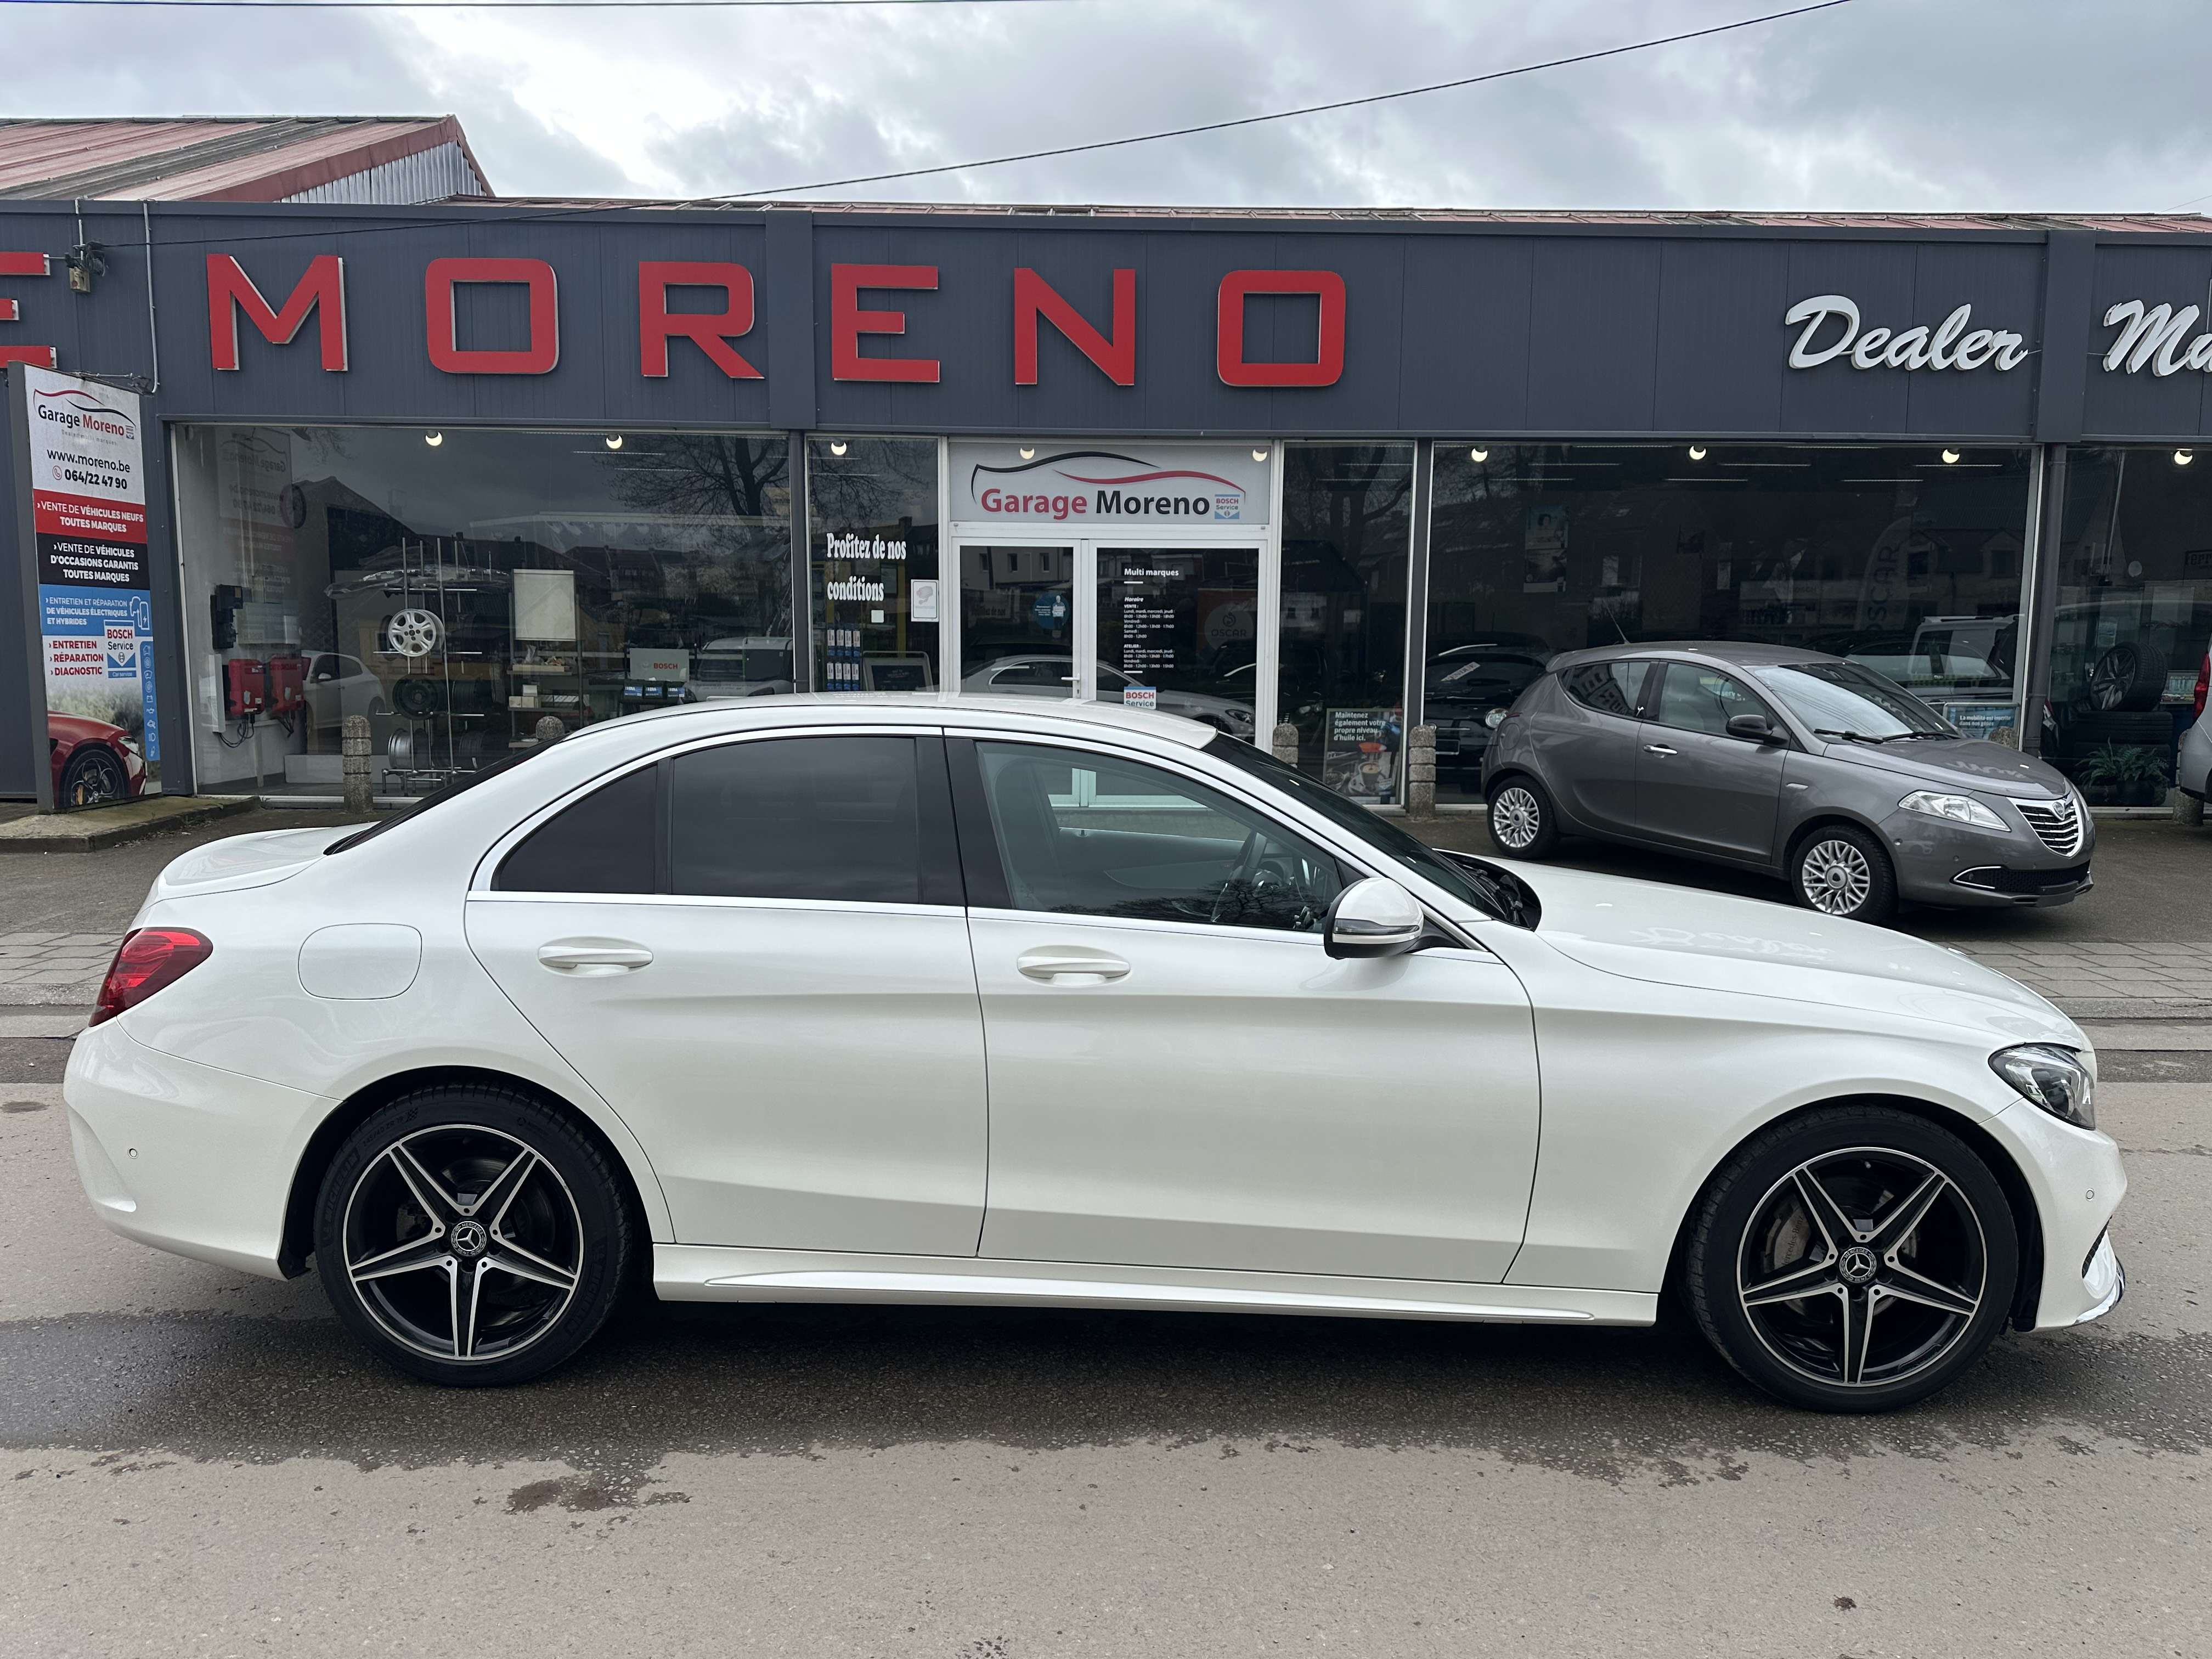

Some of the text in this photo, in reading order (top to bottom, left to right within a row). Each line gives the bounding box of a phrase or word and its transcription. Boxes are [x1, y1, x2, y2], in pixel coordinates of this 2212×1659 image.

[206, 253, 1346, 387] MORENO
[1785, 295, 2028, 370] Dealer
[38, 404, 80, 428] Garage
[83, 414, 124, 436] Moreno
[47, 449, 130, 473] www.moreno.be
[65, 469, 127, 489] 064/22 47 90
[41, 500, 143, 522] VENTE DE VÉHICULES NEUFS
[981, 488, 1210, 520] Garage Moreno
[60, 516, 127, 533] TOUTES MARQUES
[57, 542, 134, 557] VENTE DE VÉHICULES
[826, 532, 906, 560] Profitez de nos
[50, 555, 138, 571] D'OCCASIONS GARANTIS
[63, 568, 129, 583] TOUTES MARQUES
[827, 576, 884, 601] conditions
[49, 596, 83, 605] ENTRETIEN
[93, 598, 127, 607] RÉPARATION
[56, 606, 89, 616] VÉHICULES
[90, 607, 128, 617] ÉLECTRIQUES
[107, 629, 133, 639] BOSCH
[1211, 628, 1247, 637] OSCAR
[53, 640, 97, 649] ENTRETIEN
[108, 641, 133, 650] Service
[54, 651, 104, 662] RÉPARATION
[54, 667, 103, 676] DIAGNOSTIC
[1335, 719, 1368, 727] également
[461, 1222, 484, 1235] MERCEDES
[1844, 1248, 1869, 1258] MERCEDES
